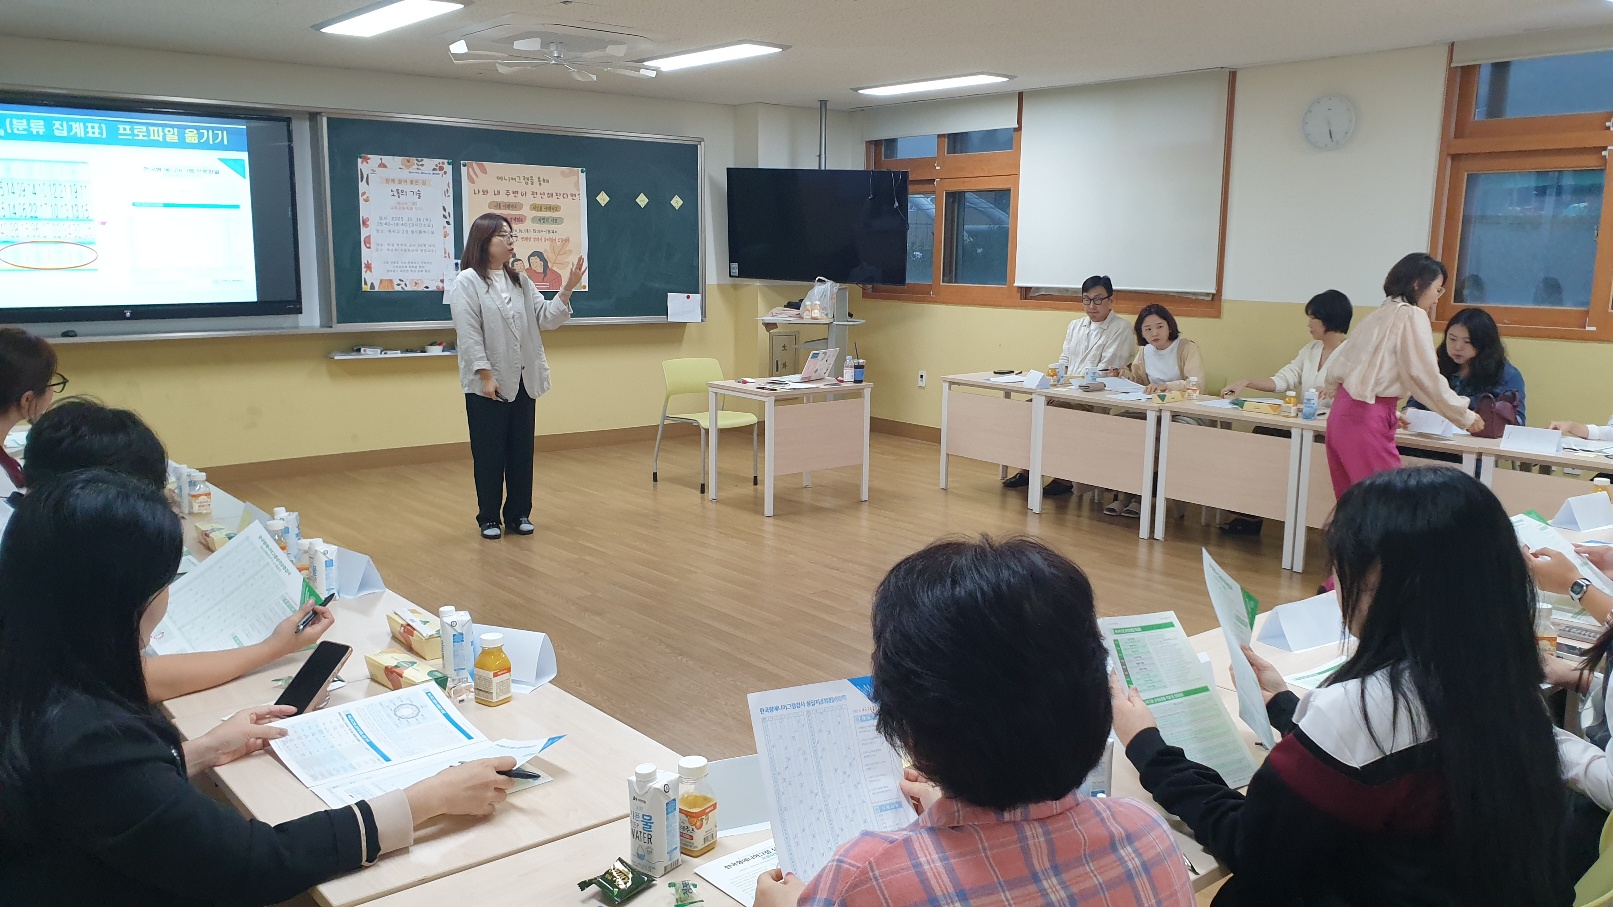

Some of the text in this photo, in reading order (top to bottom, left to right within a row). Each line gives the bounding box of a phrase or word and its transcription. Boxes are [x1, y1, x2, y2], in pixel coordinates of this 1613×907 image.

[5, 118, 228, 145] (분류 집계표) 프로파일 옮기기
[537, 176, 550, 187] 통해
[409, 189, 422, 200] 기술
[473, 189, 489, 197] 나와
[504, 189, 528, 198] 주변이
[641, 813, 655, 833] 물
